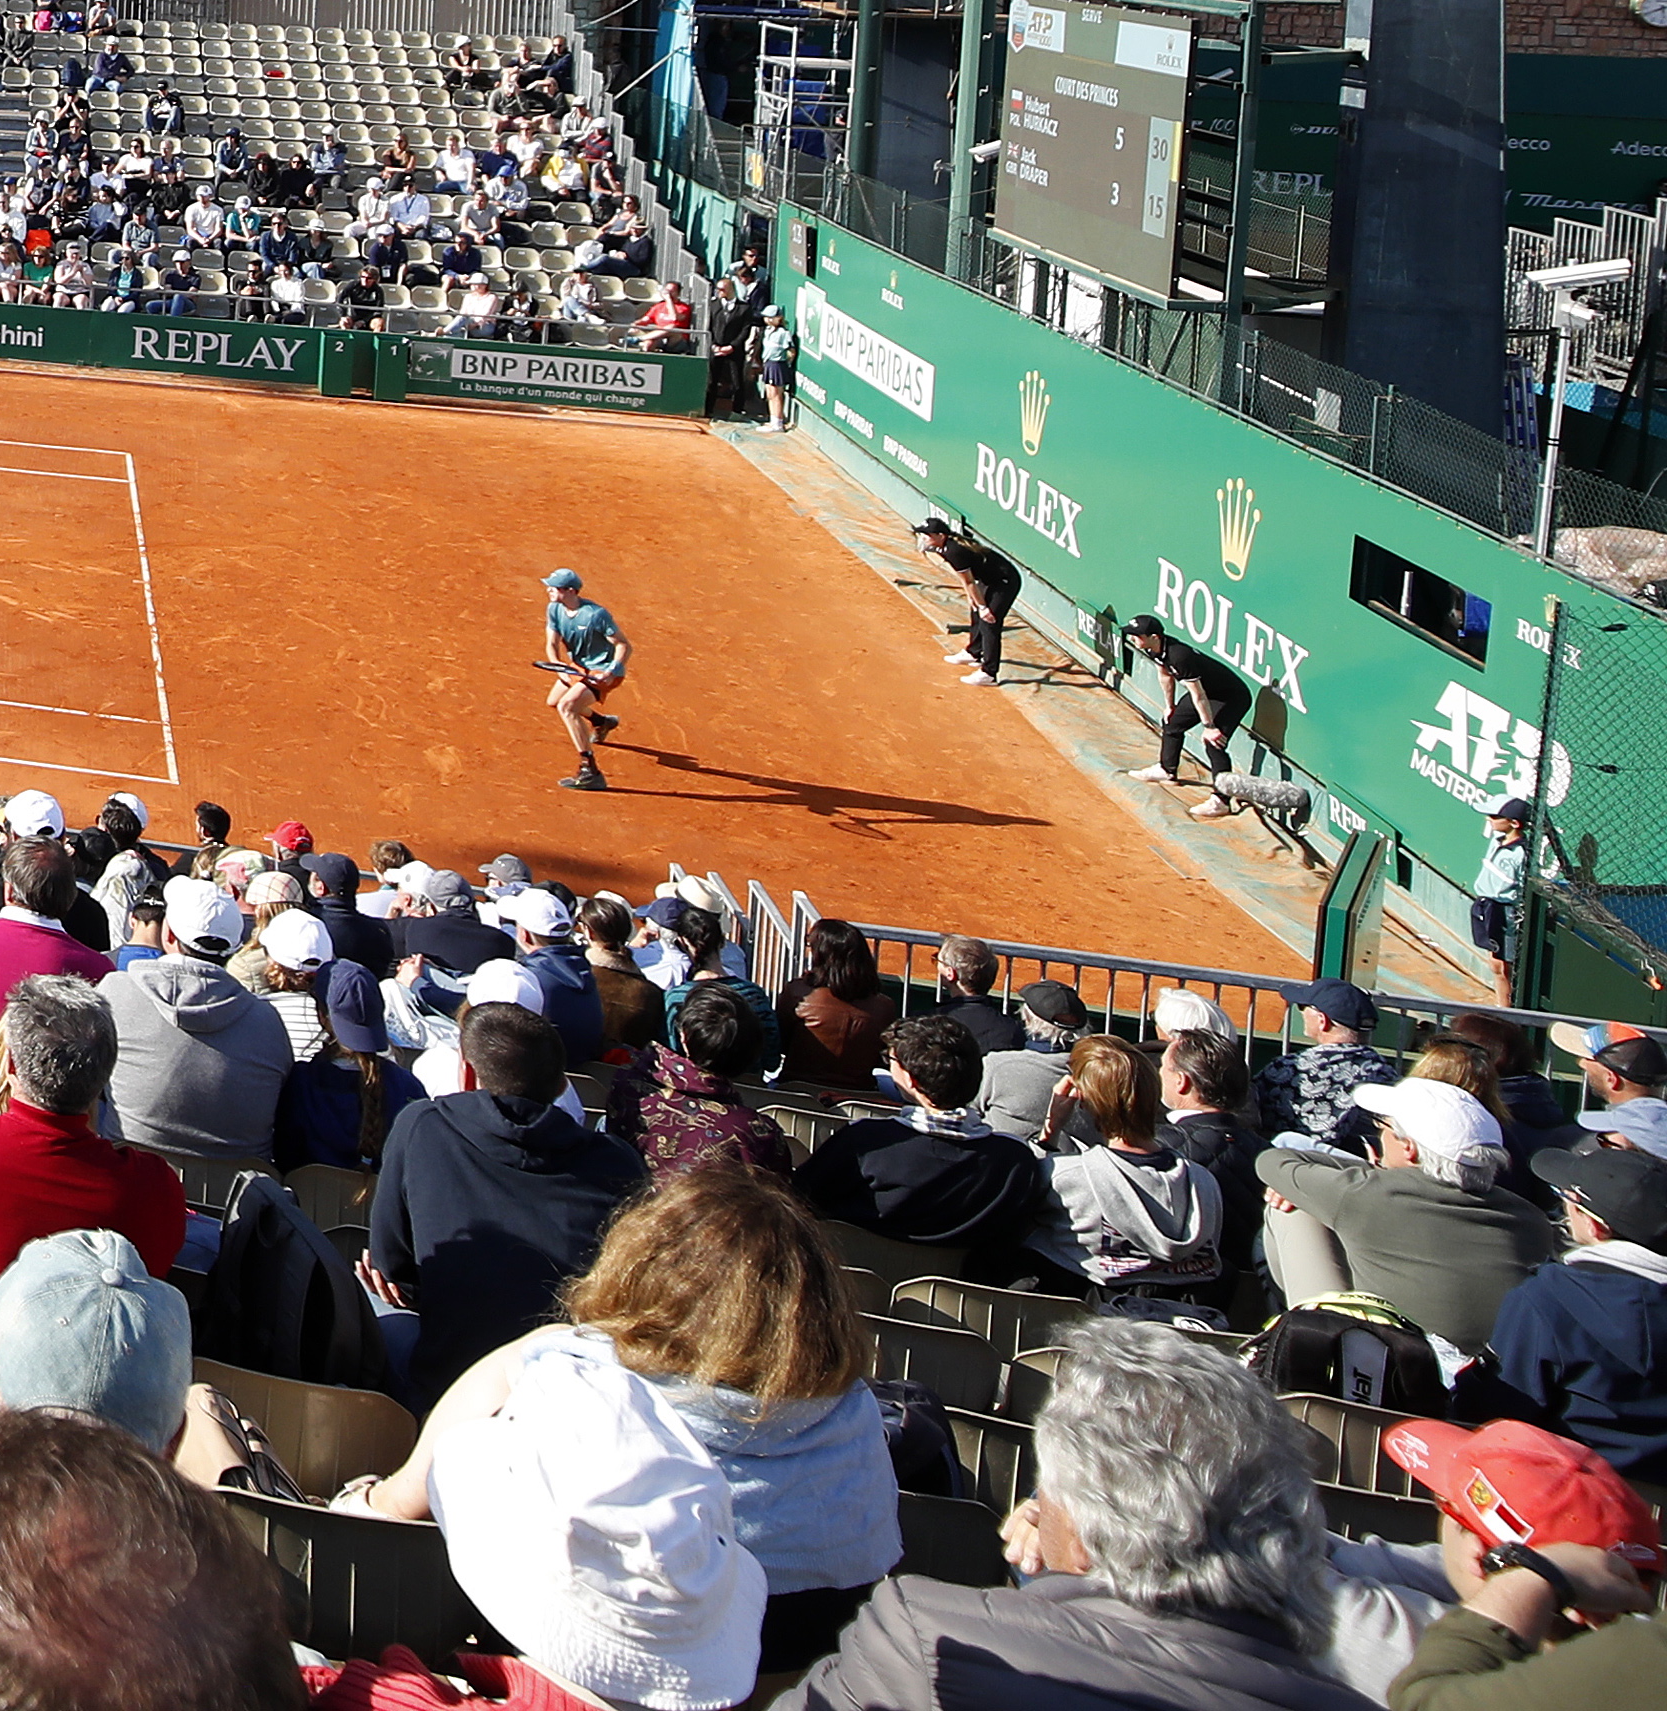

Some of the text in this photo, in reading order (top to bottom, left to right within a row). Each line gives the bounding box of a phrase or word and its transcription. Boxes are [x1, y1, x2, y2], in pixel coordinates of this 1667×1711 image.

[1156, 53, 1183, 70] ROLEX
[1115, 127, 1168, 161] 5 30
[1507, 138, 1551, 151] ecco
[1020, 162, 1049, 187] DRAPER
[1110, 182, 1164, 219] 3 15
[131, 326, 306, 372] REPLAY
[335, 341, 344, 352] 2
[390, 345, 397, 356] 1
[825, 312, 924, 406] BNP PARIBAS
[461, 354, 646, 388] BNP PARIBAS
[460, 381, 646, 407] La banque d'un monde qui change
[897, 444, 929, 478] PARIBAS
[974, 442, 1083, 559] ROLEX
[1077, 607, 1123, 658] REPLAY
[1154, 556, 1311, 715] ROLEX
